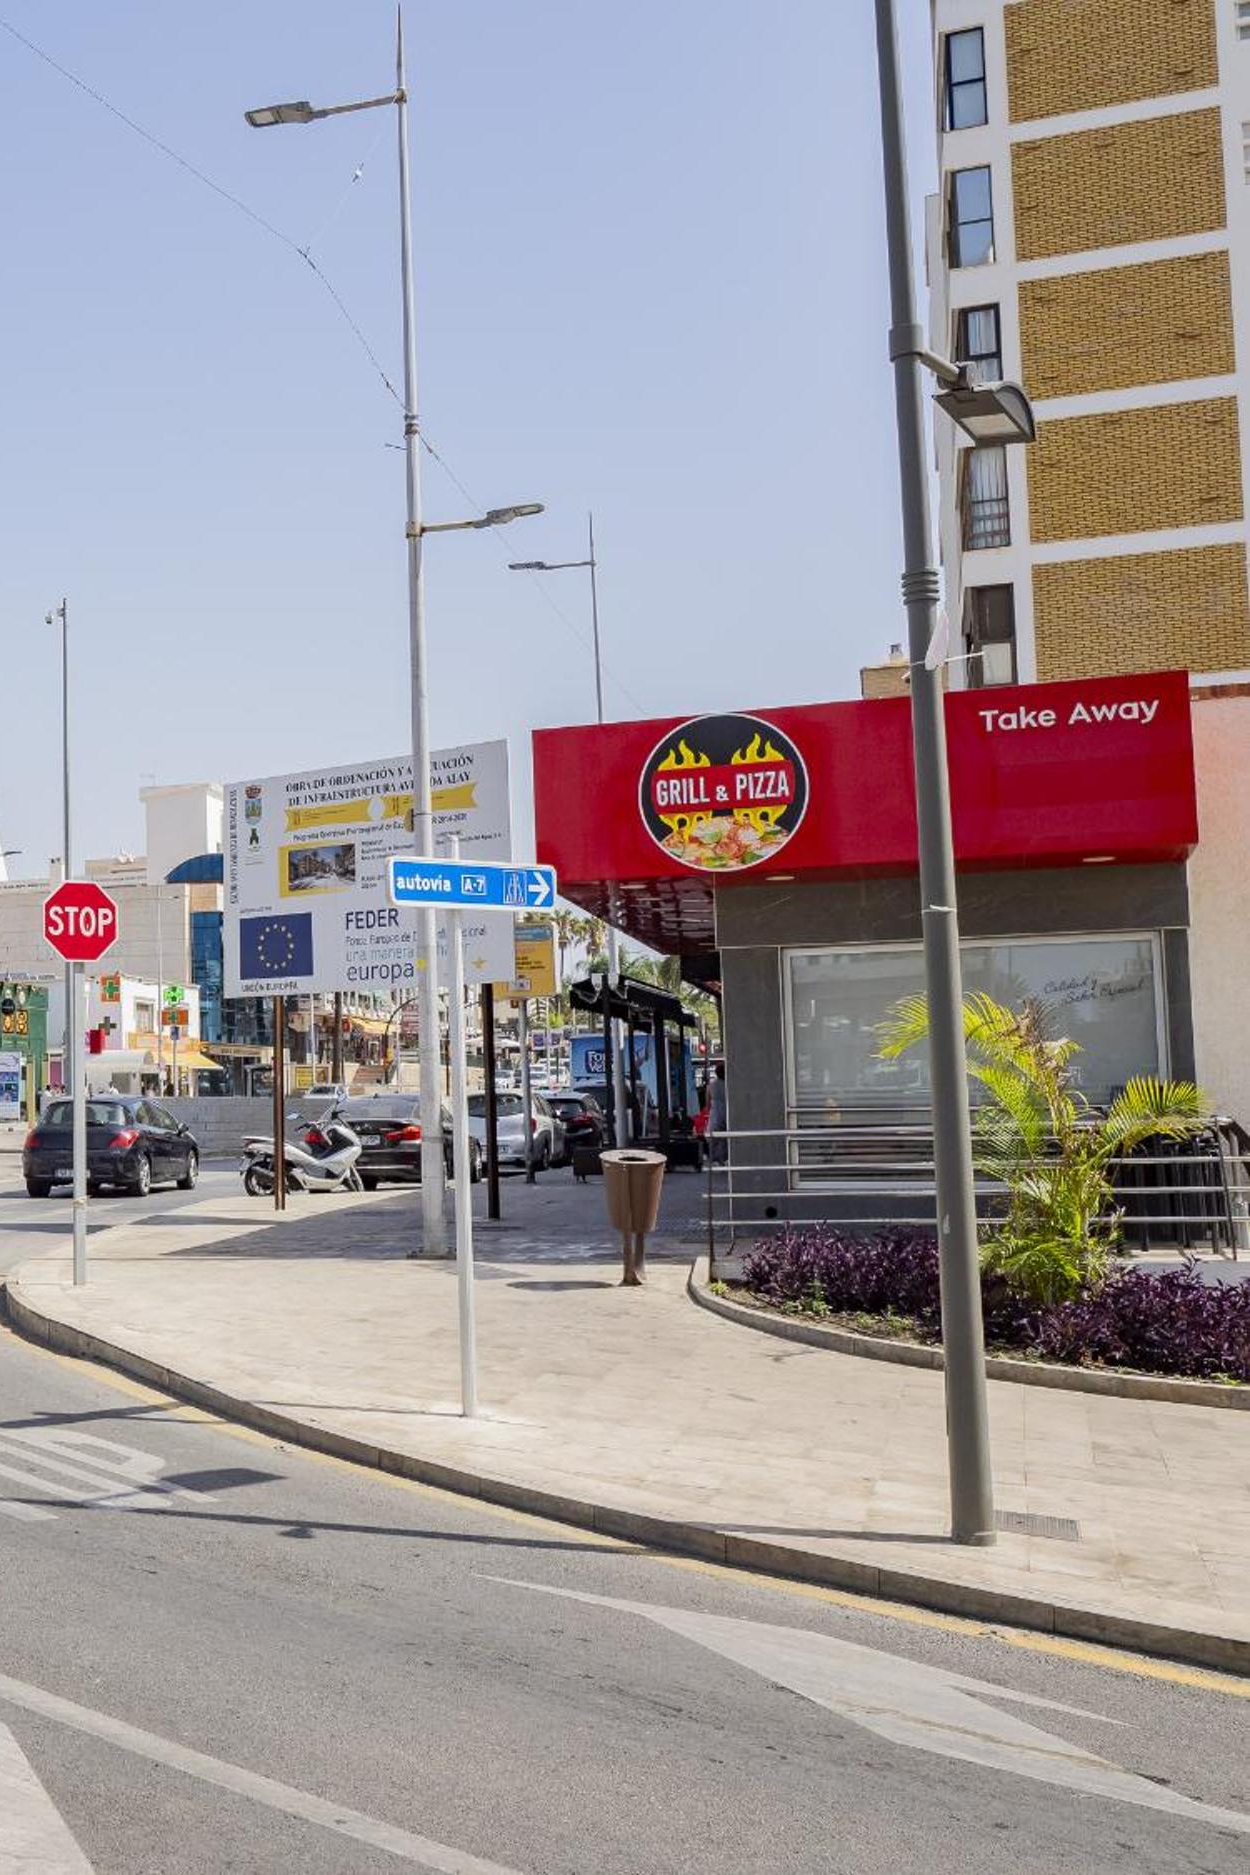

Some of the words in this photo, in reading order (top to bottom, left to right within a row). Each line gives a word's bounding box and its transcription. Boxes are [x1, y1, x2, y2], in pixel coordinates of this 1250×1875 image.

[979, 705, 1057, 733] Take
[1068, 698, 1160, 727] Away
[655, 776, 710, 808] GRILL
[716, 784, 730, 802] &
[735, 770, 790, 802] PIZZA
[47, 906, 113, 938] STOP
[346, 908, 400, 931] FEDER
[347, 961, 415, 984] europa
